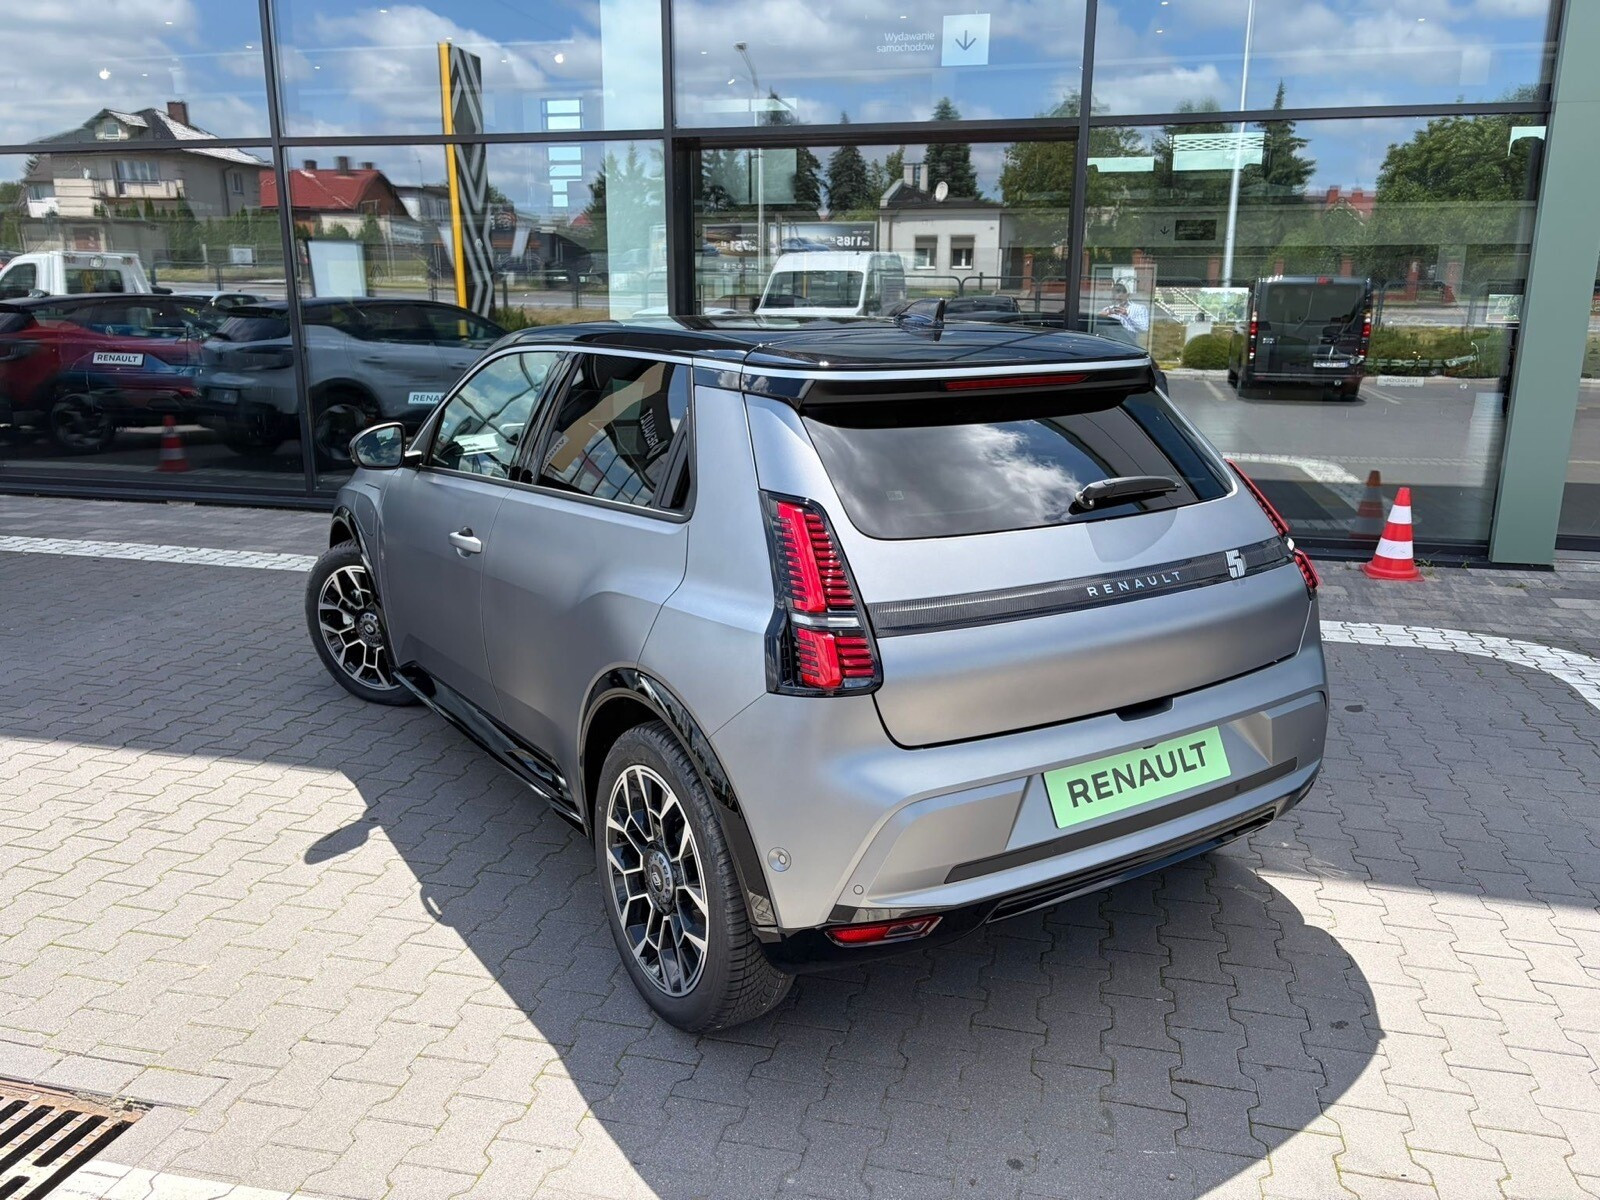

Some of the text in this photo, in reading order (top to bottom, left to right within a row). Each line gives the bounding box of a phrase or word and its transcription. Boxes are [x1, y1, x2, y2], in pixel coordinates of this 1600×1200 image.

[884, 31, 935, 43] Wydawanie
[876, 43, 935, 53] samochodów
[96, 354, 139, 363] RENAULT
[412, 394, 443, 402] RENA
[1086, 571, 1180, 597] RENAULT
[1066, 740, 1207, 808] RENAULT
